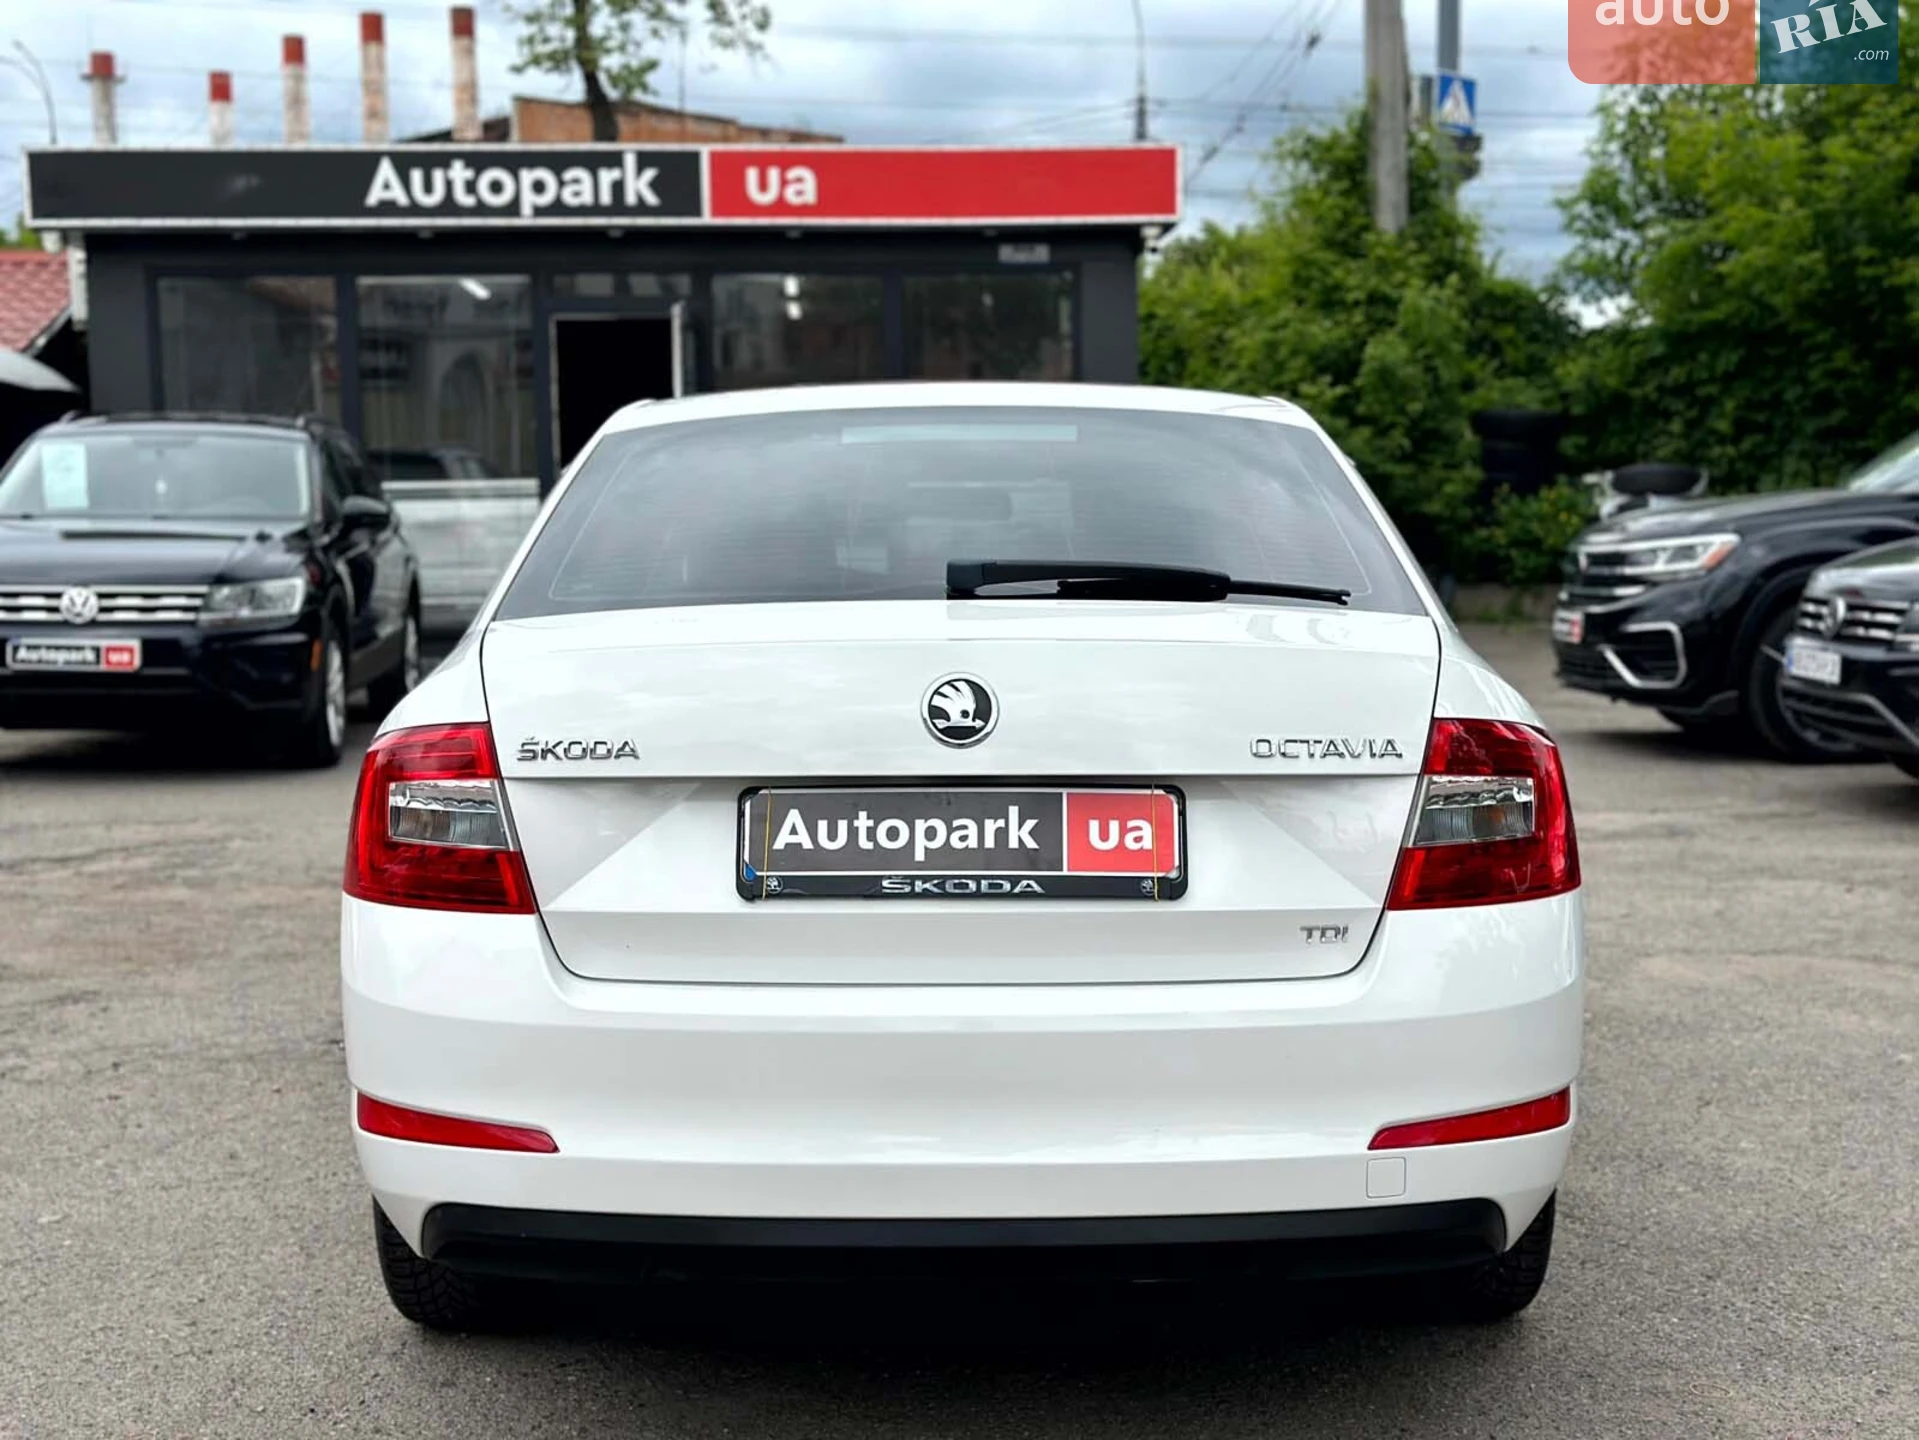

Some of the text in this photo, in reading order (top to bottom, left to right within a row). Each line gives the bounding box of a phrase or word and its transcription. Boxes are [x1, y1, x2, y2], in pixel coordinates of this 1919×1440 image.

[364, 151, 818, 217] Autopark ua
[516, 735, 641, 761] ŠKODA
[1250, 738, 1404, 759] OCTAVIA
[771, 805, 1155, 862] Autopark ua
[881, 875, 1046, 894] ŠKODA
[1299, 925, 1349, 944] TDI
